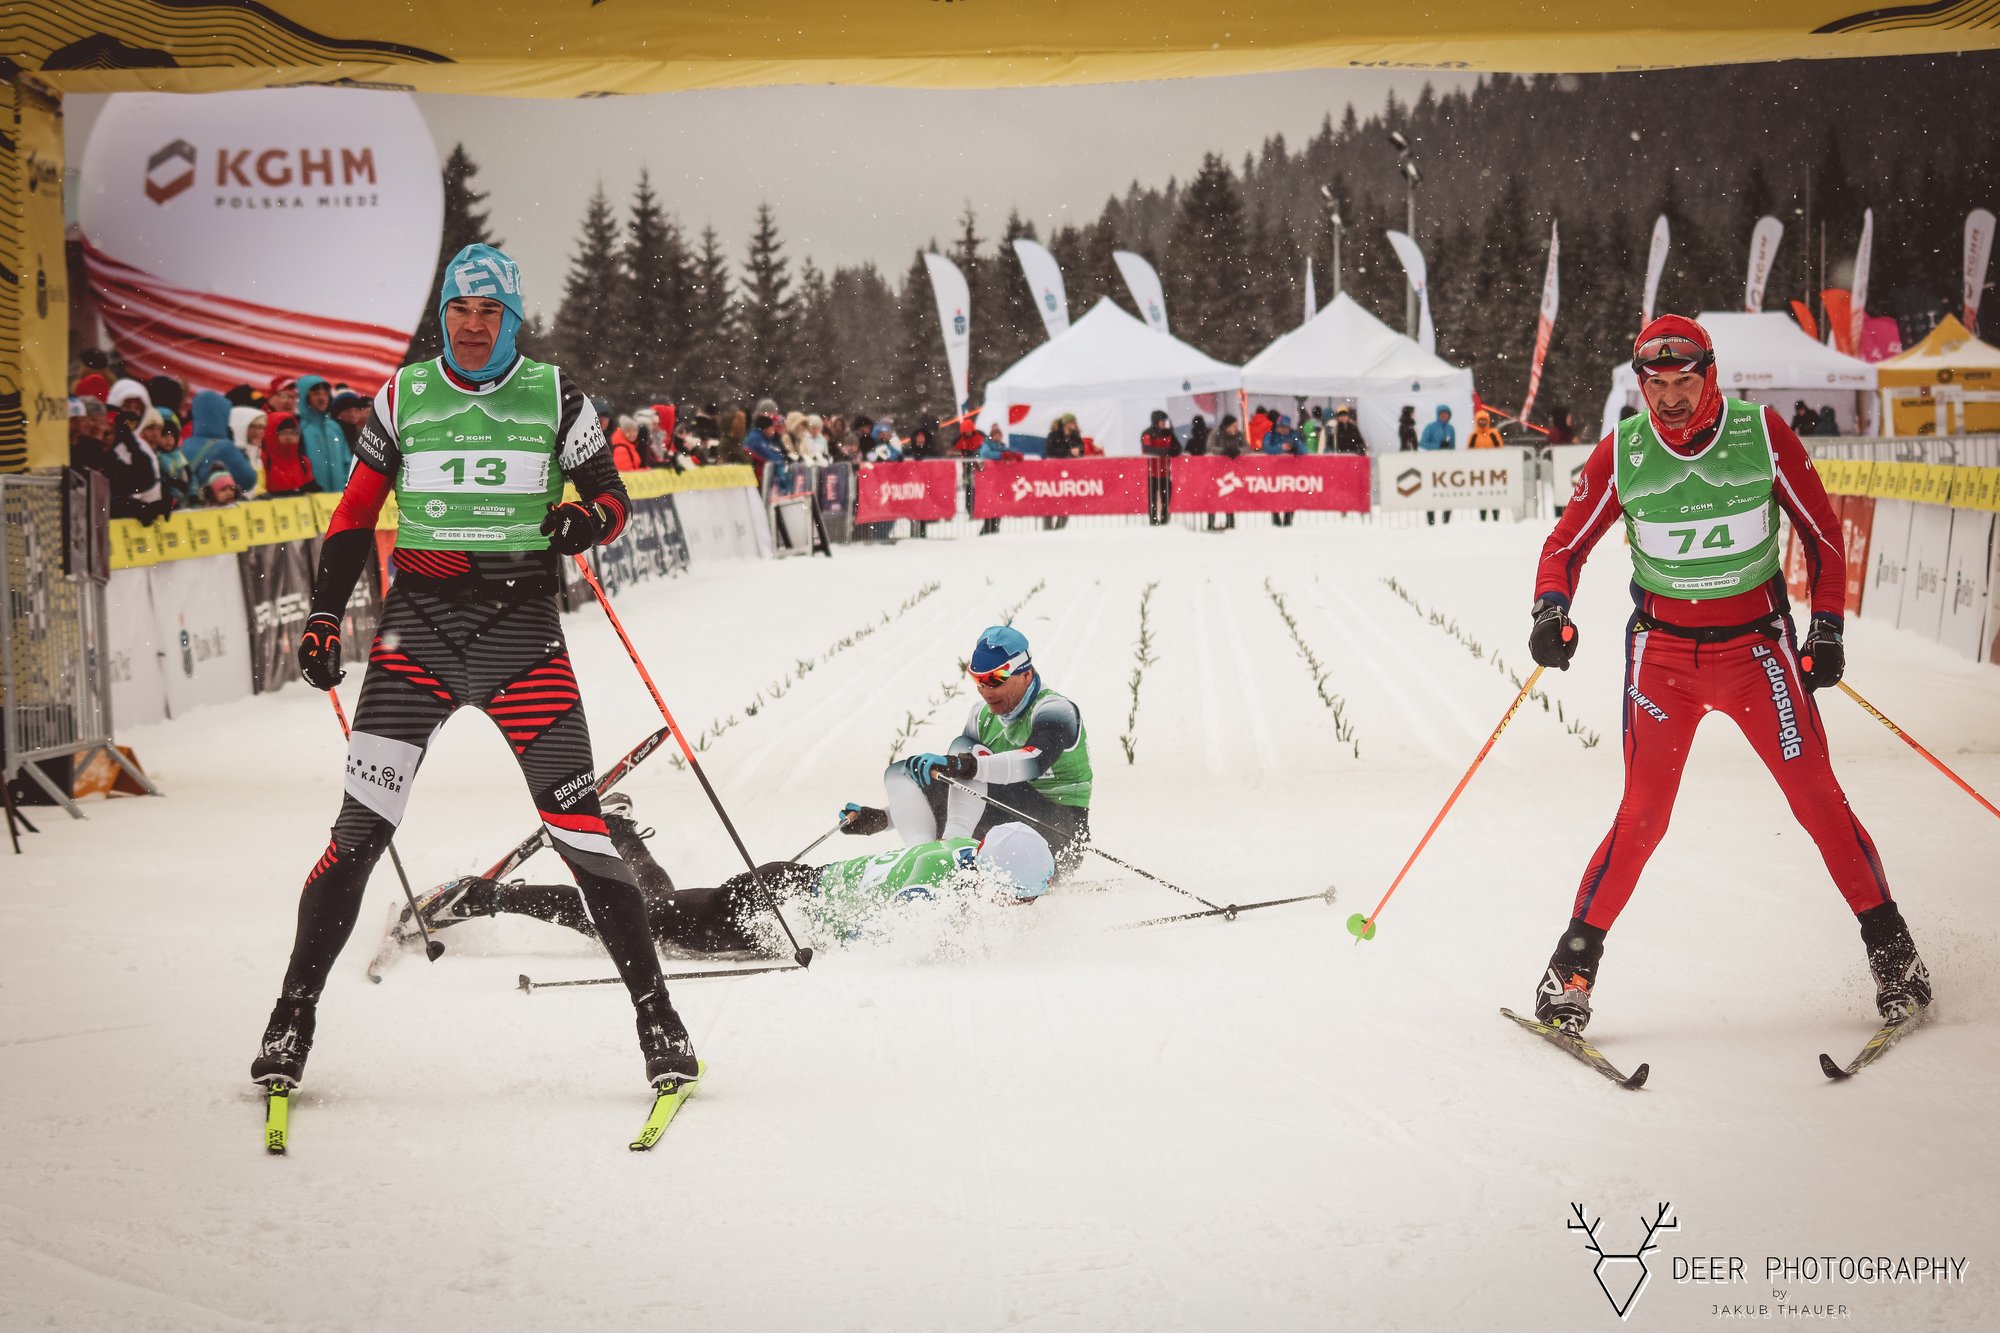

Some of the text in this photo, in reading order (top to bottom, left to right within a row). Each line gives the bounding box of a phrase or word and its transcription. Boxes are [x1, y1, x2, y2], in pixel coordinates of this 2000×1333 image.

[216, 147, 377, 187] KGHM
[214, 195, 305, 209] POLSKA
[440, 458, 507, 486] 13
[1432, 469, 1508, 488] KGHM
[1033, 480, 1104, 497] TAURON
[1244, 475, 1323, 493] TAURON
[1691, 503, 1713, 512] KGHM
[1668, 524, 1735, 555] 74
[1627, 684, 1670, 723] TRIMTEX
[1762, 657, 1802, 762] Björnstorps
[361, 769, 401, 794] KALIBR
[560, 796, 577, 811] NAD
